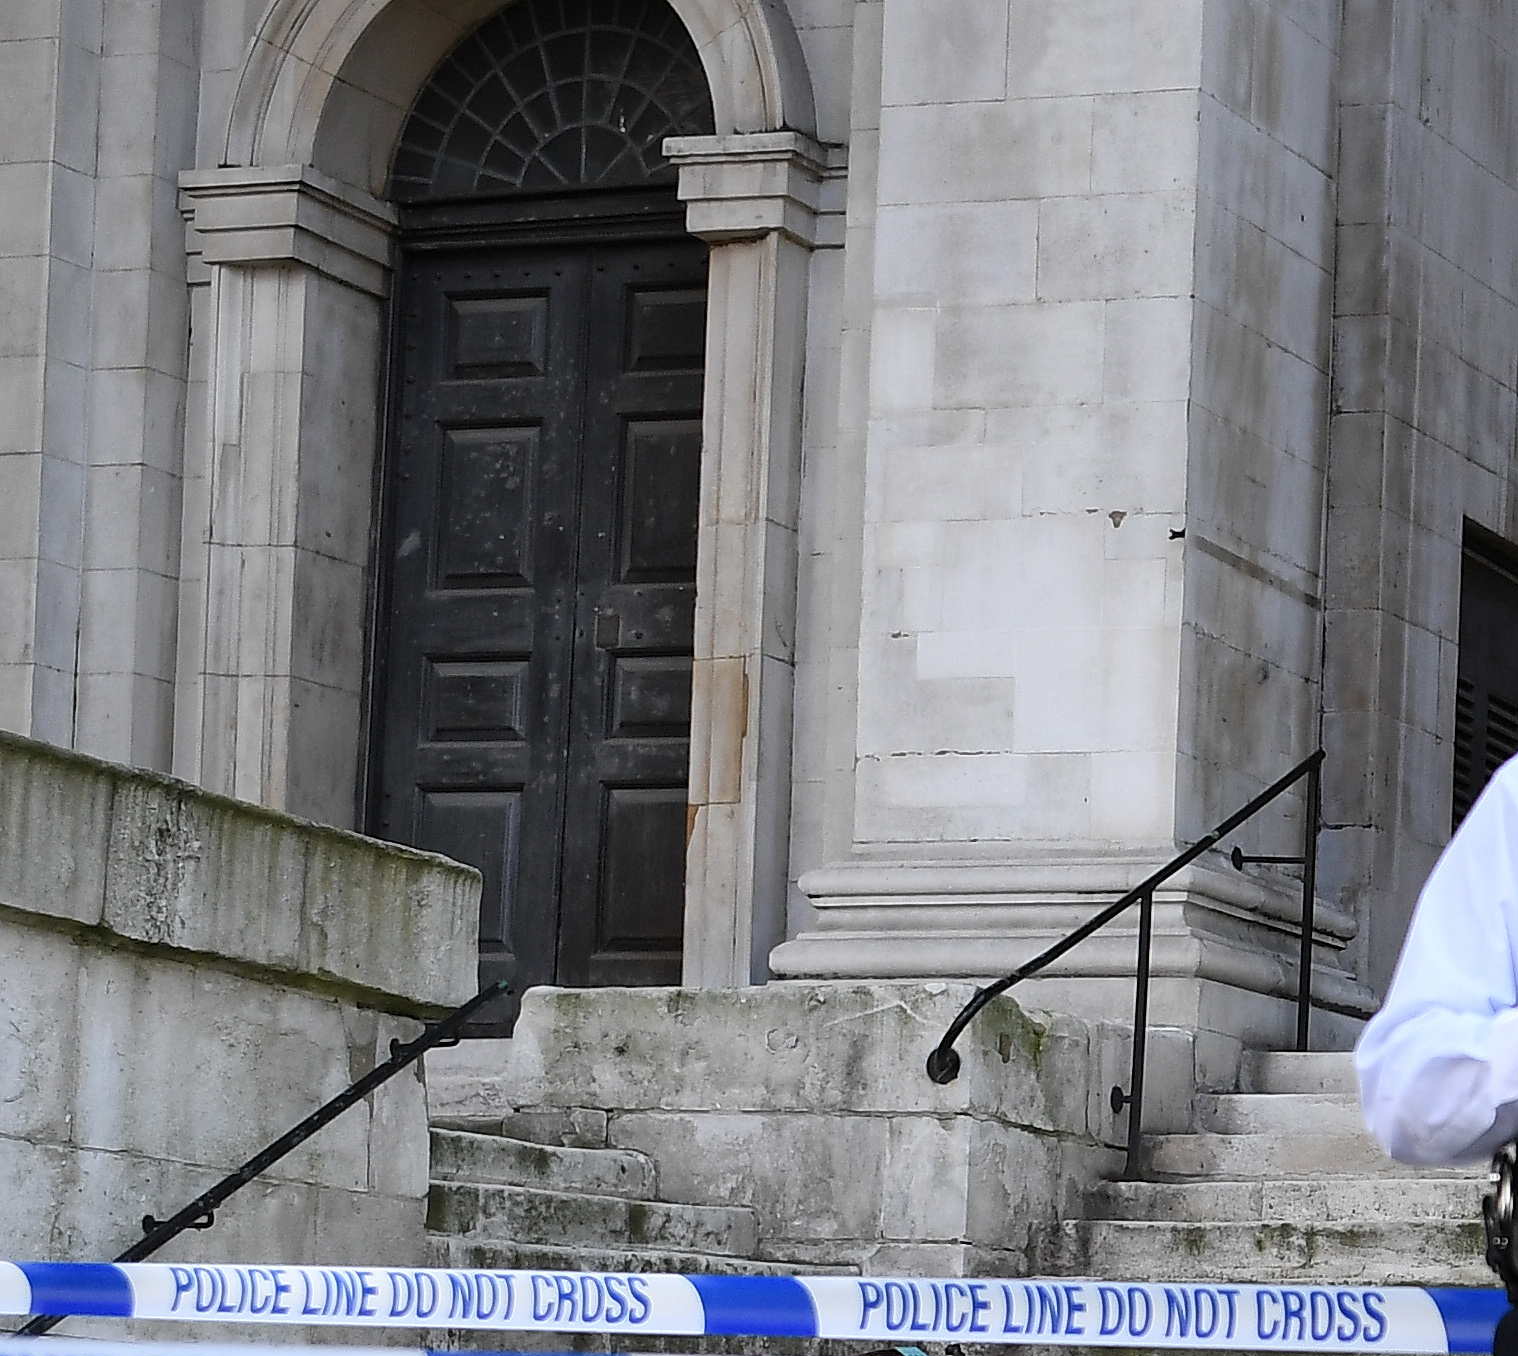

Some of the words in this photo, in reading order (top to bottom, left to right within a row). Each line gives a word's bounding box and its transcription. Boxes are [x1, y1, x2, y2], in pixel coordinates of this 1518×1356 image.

[168, 1266, 291, 1315] POLICE
[299, 1270, 377, 1317] LINE
[388, 1272, 436, 1318] DO
[446, 1273, 517, 1321] NOT
[530, 1274, 652, 1325] CROSS
[857, 1280, 989, 1334] POLICE
[1000, 1283, 1087, 1336] LINE
[1098, 1285, 1151, 1338] DO
[1164, 1286, 1241, 1340] NOT
[1256, 1288, 1387, 1344] CROSS
